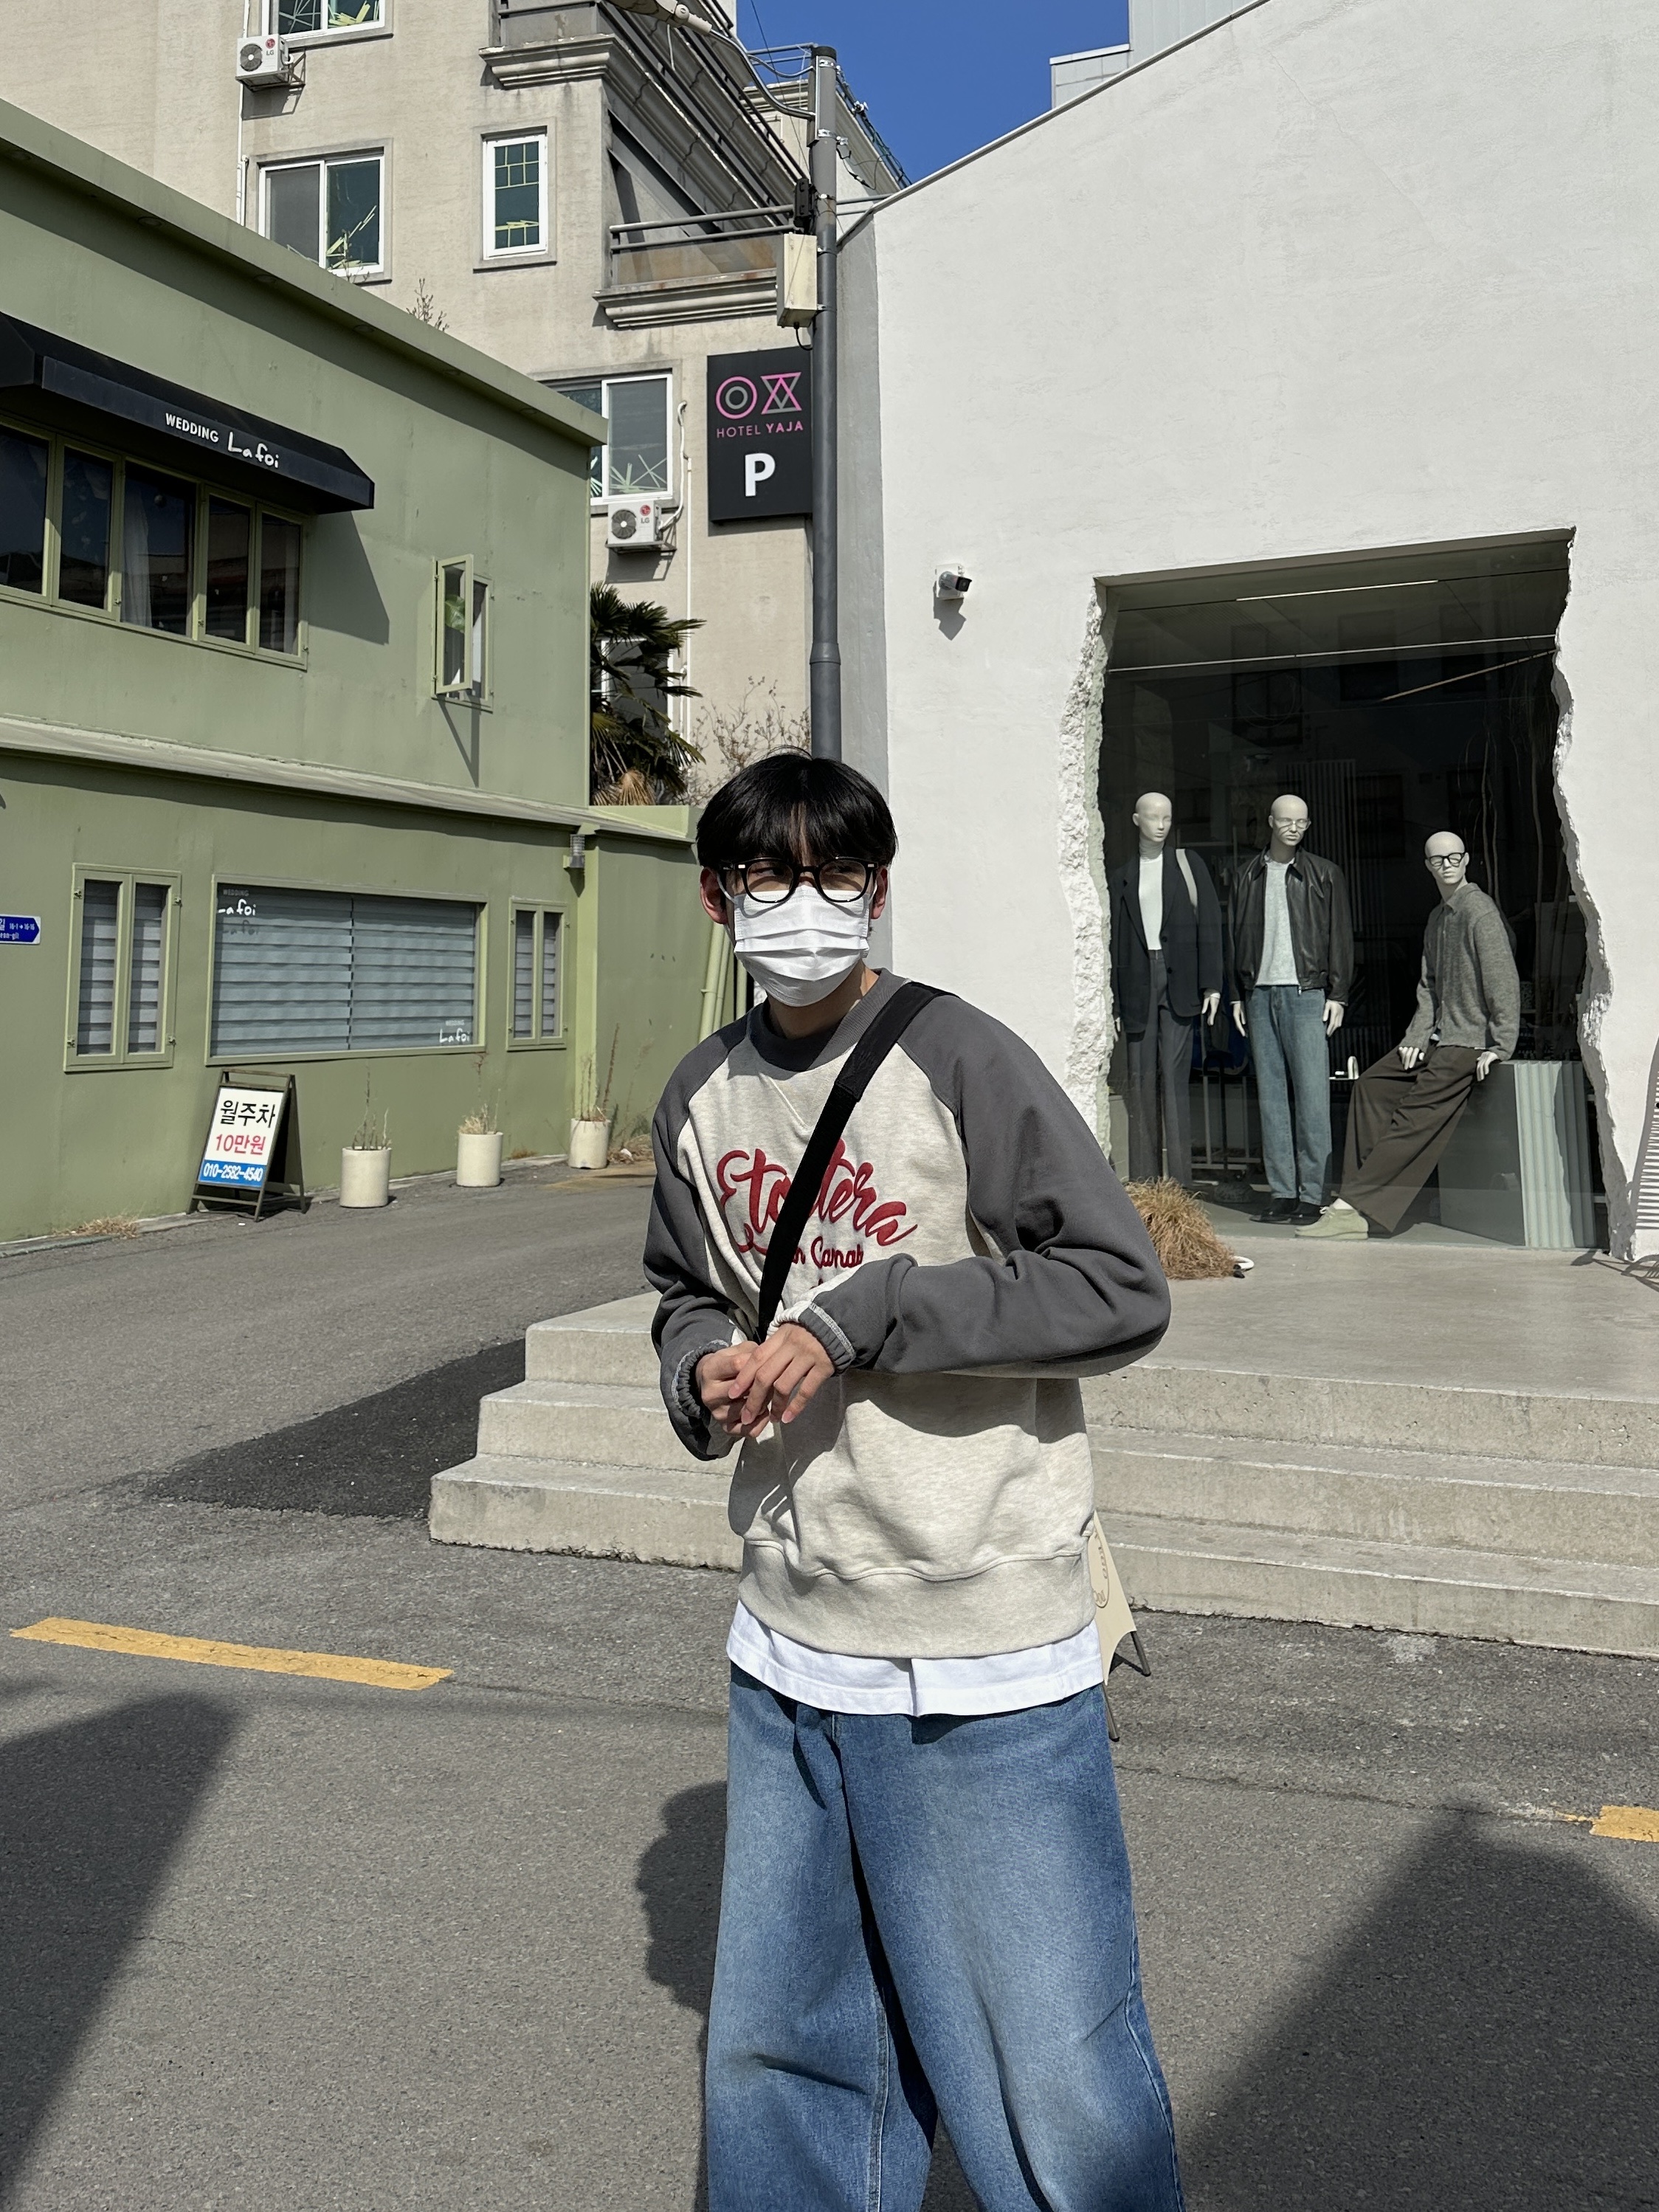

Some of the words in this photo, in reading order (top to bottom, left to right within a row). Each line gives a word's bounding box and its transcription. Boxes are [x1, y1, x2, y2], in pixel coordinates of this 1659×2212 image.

[165, 413, 219, 443] WEDDING
[716, 424, 761, 438] HOTEL
[765, 420, 804, 434] YAJA
[745, 452, 776, 497] P
[220, 1100, 276, 1129] 월주차
[215, 1134, 266, 1156] 10만원
